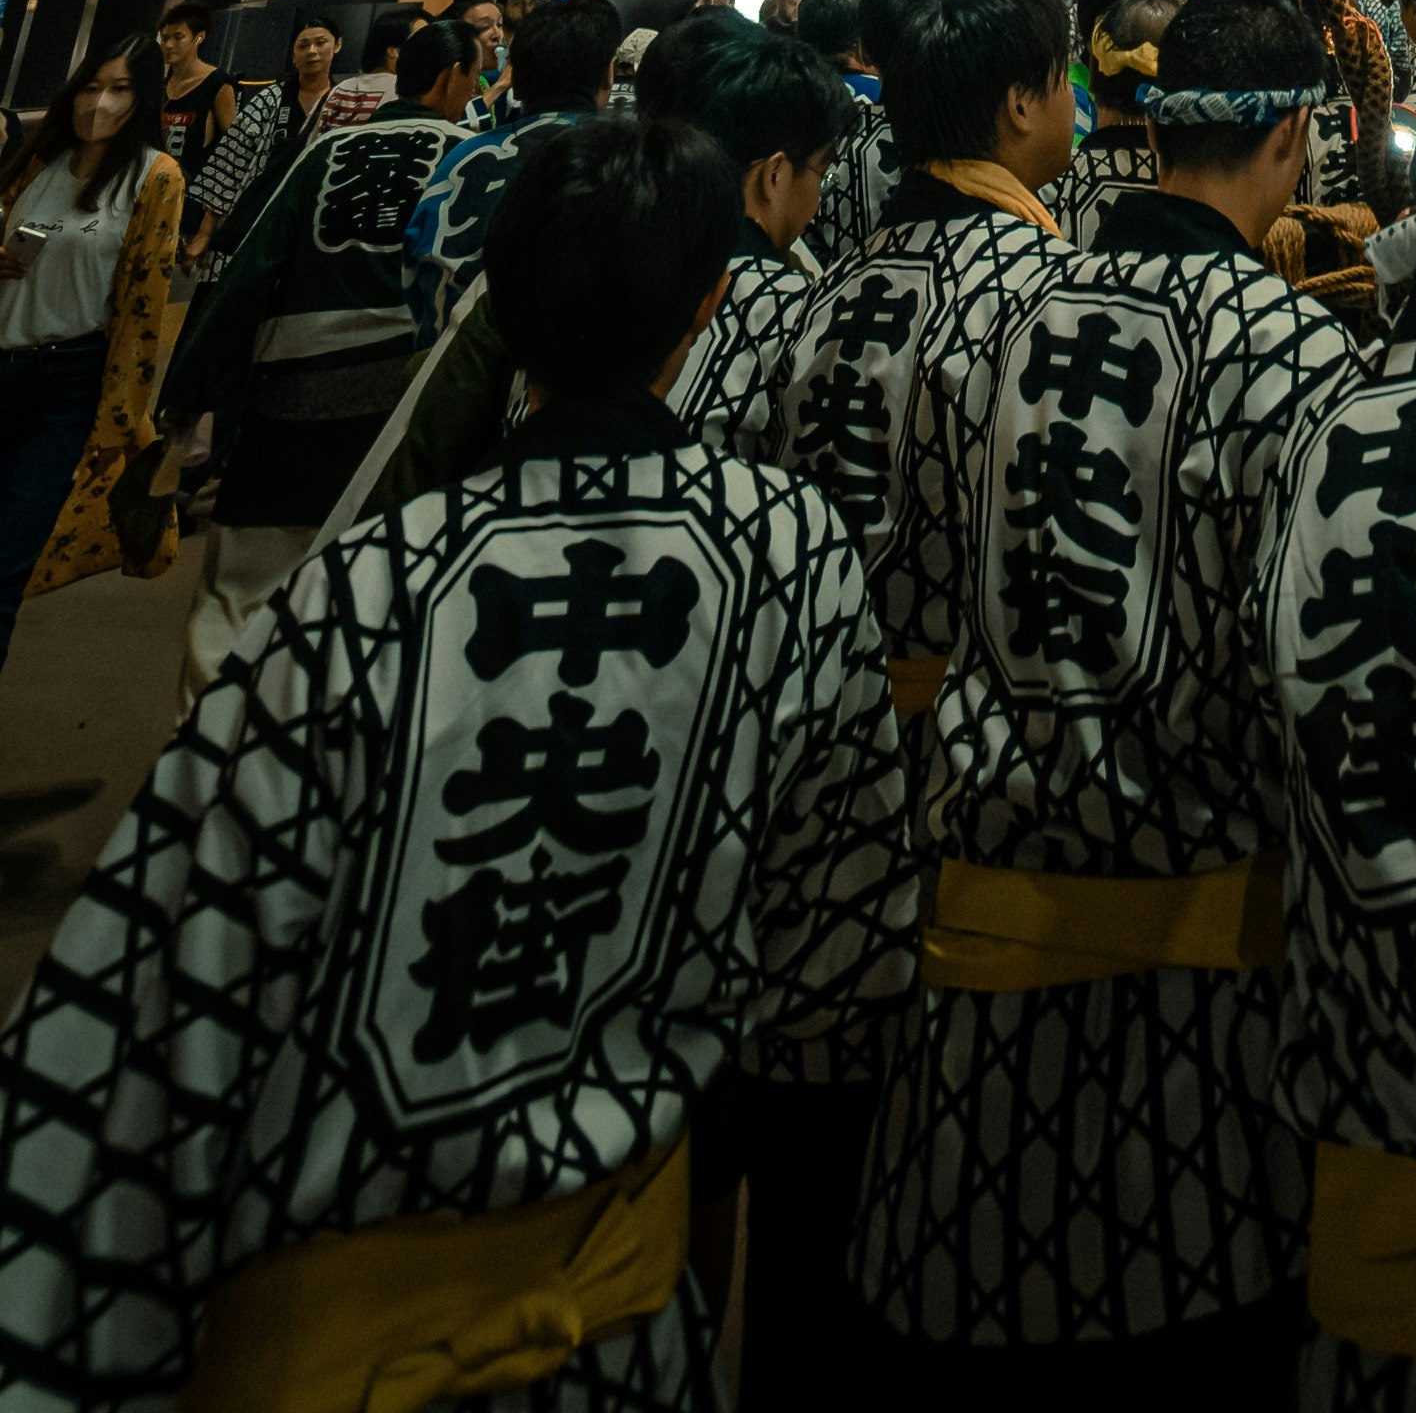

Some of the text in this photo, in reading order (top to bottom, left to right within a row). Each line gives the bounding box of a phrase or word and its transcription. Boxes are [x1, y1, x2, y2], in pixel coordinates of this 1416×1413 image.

[1002, 311, 1164, 676] 中央街
[411, 537, 700, 1062] 中央街
